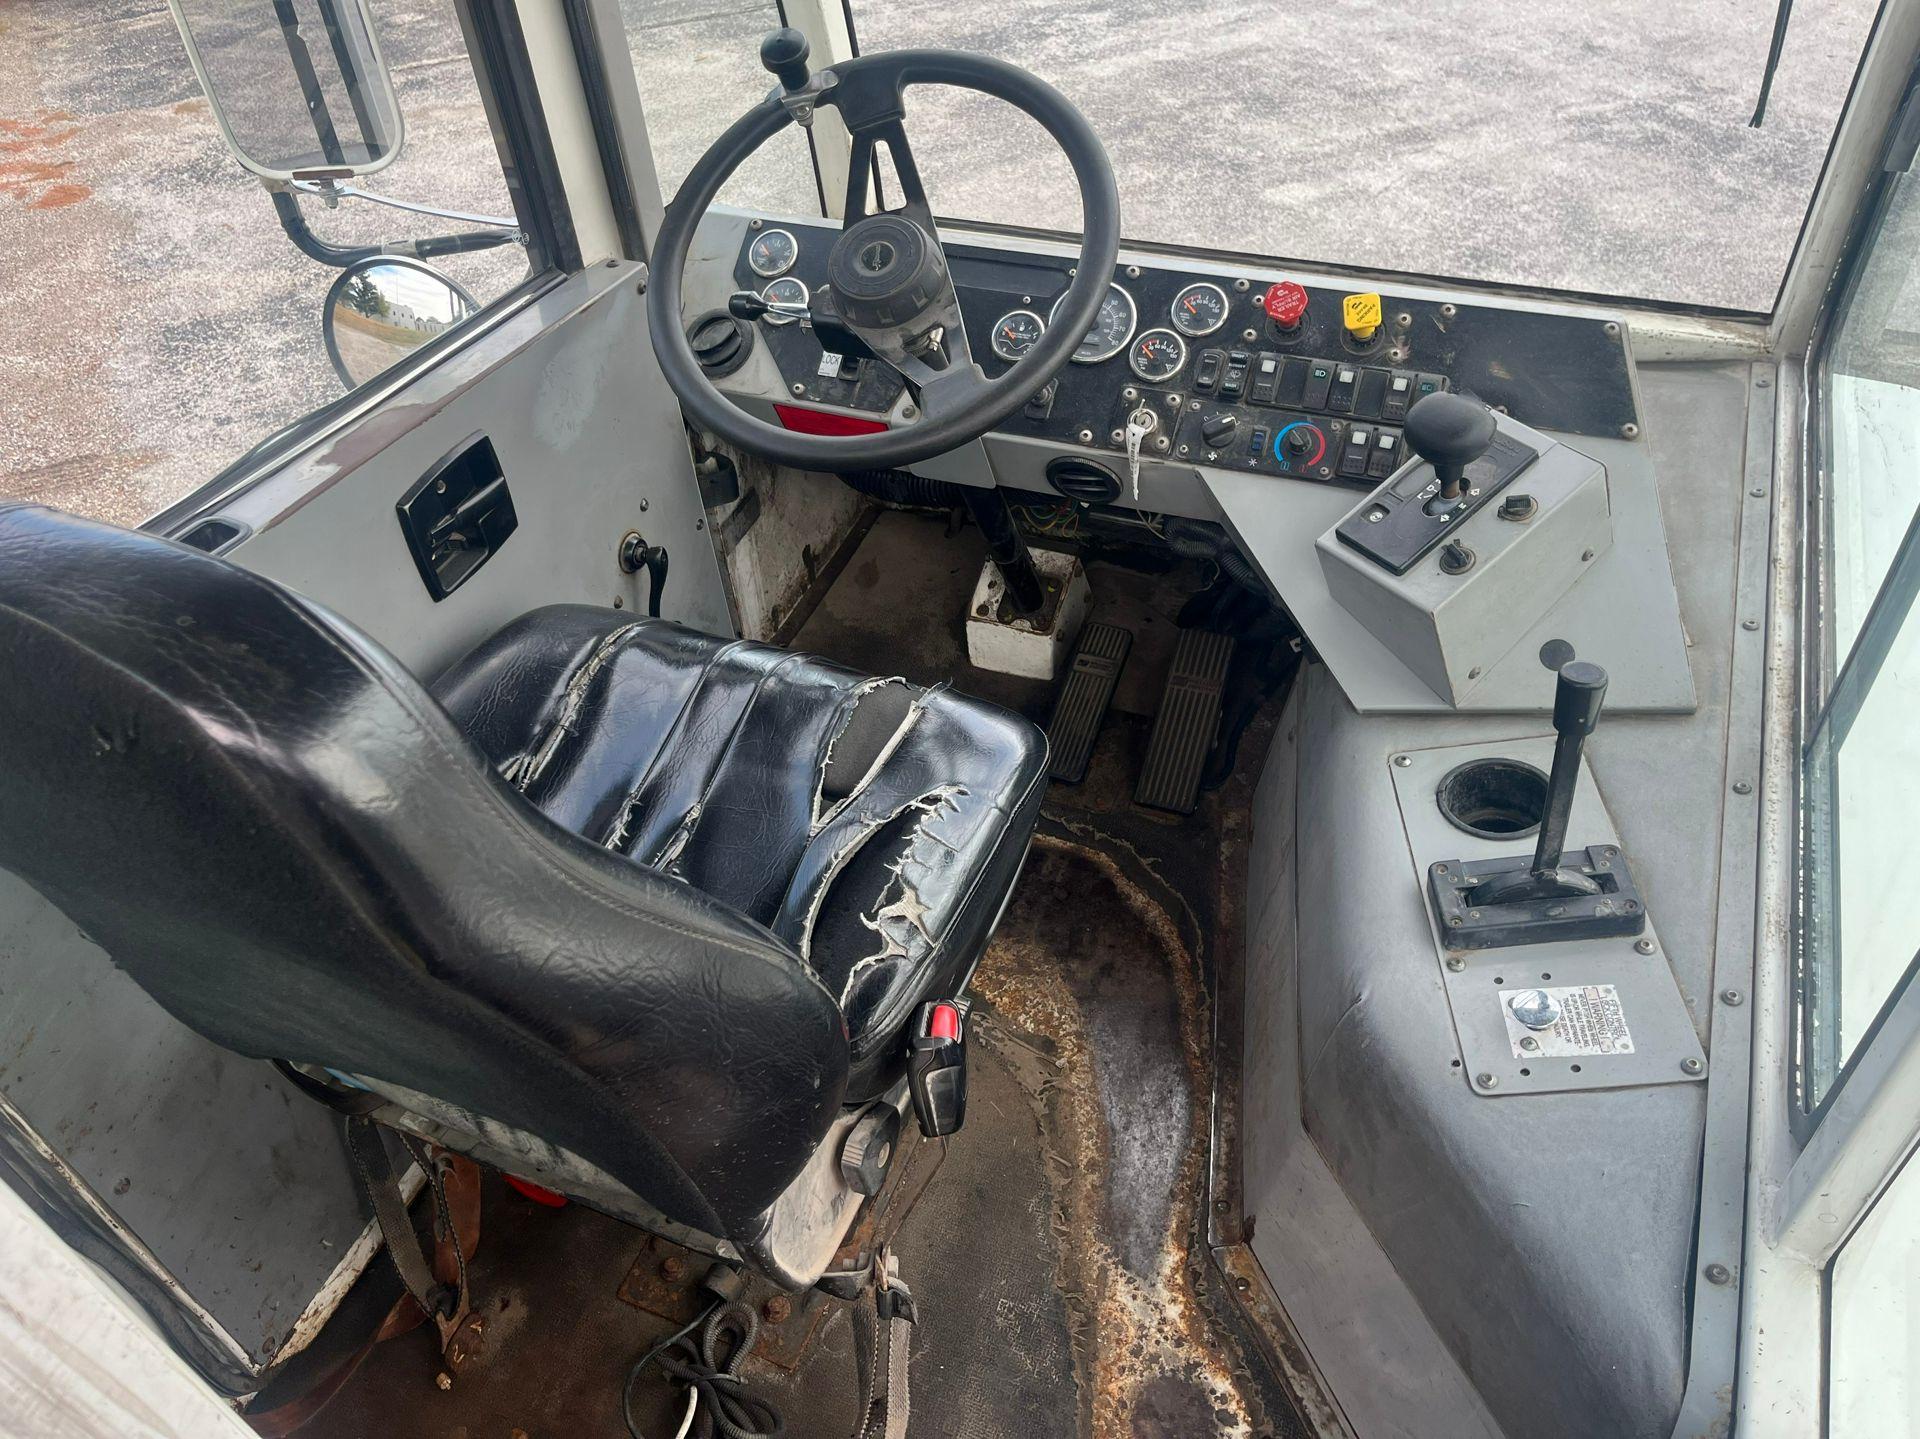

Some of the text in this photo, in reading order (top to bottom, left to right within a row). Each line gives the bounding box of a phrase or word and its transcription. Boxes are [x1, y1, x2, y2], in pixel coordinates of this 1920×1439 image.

[1589, 1001, 1608, 1035] WARNING
[1608, 999, 1627, 1037] FIFTH WHEEL
[1589, 1032, 1598, 1046] WHEEL
